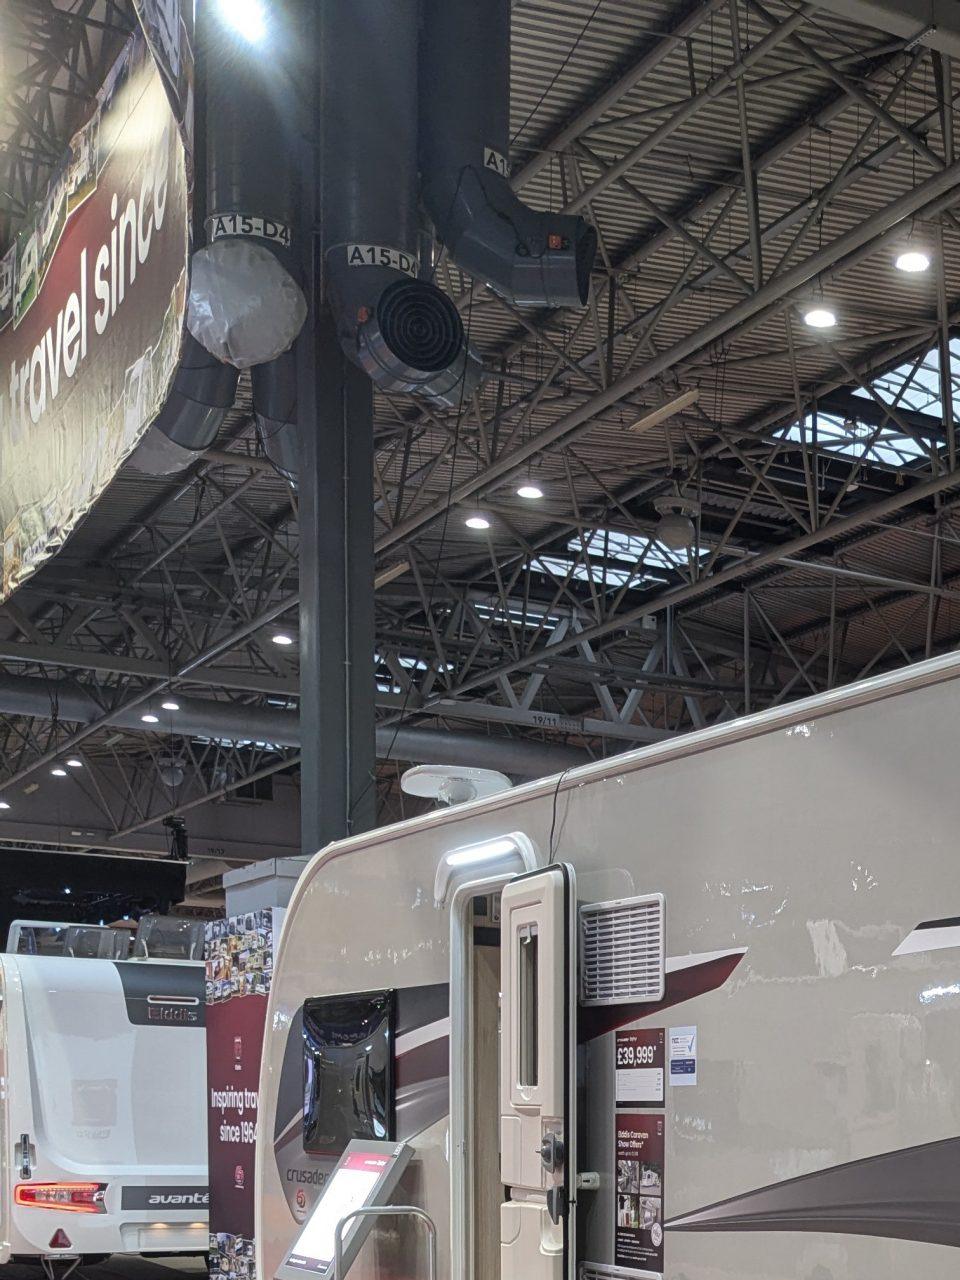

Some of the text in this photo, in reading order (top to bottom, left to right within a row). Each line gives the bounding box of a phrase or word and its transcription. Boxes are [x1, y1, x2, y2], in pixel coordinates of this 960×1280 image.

[215, 216, 290, 243] A15-D4
[9, 248, 87, 440] travel
[211, 1085, 244, 1116] Inspiring
[220, 1120, 240, 1142] since
[286, 1168, 330, 1186] crusader
